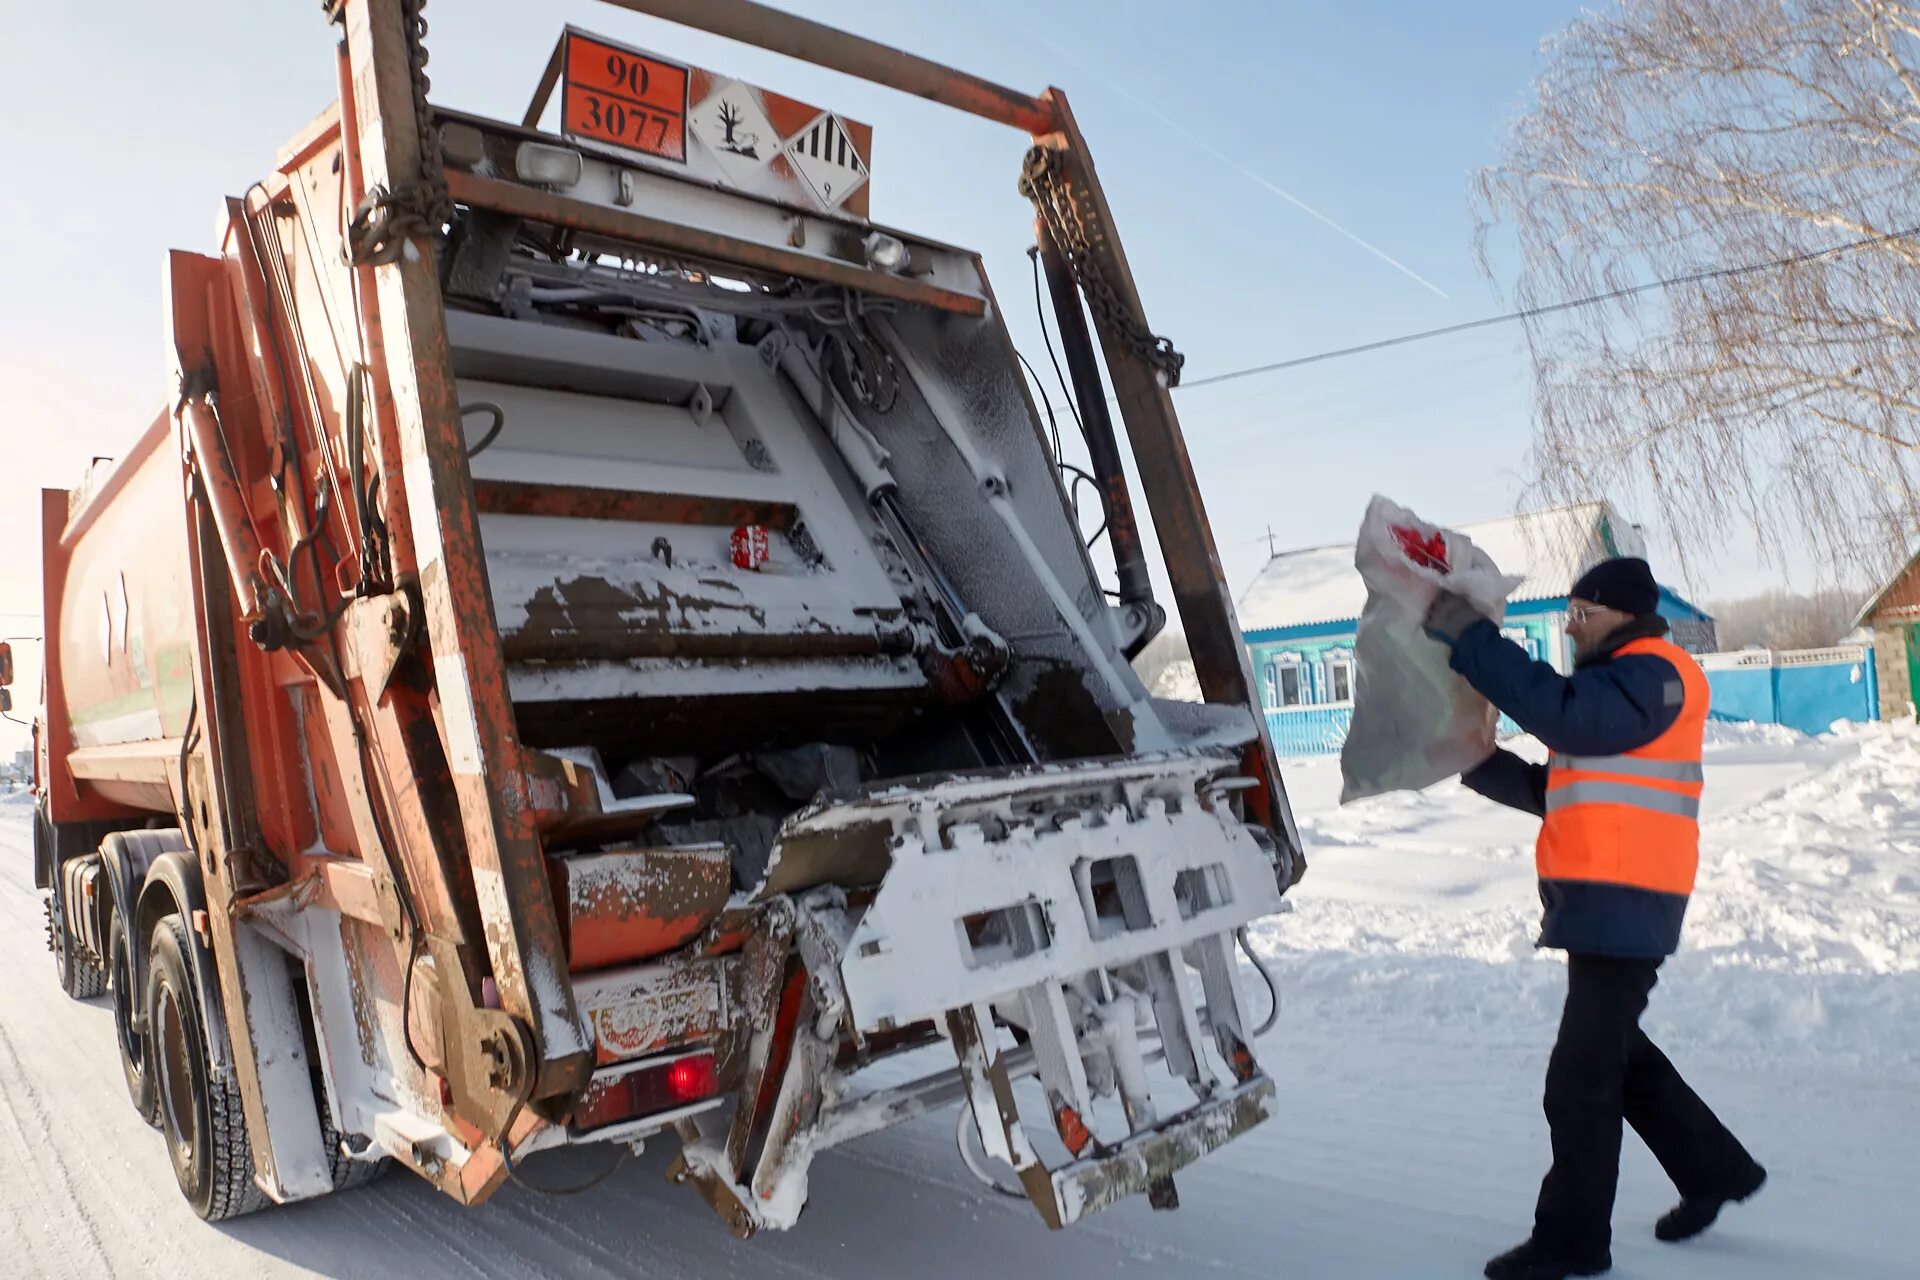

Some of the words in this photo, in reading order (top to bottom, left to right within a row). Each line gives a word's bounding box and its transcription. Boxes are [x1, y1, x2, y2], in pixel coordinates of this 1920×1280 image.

[607, 55, 649, 96] 90
[581, 96, 669, 149] 3077
[823, 182, 832, 199] 9
